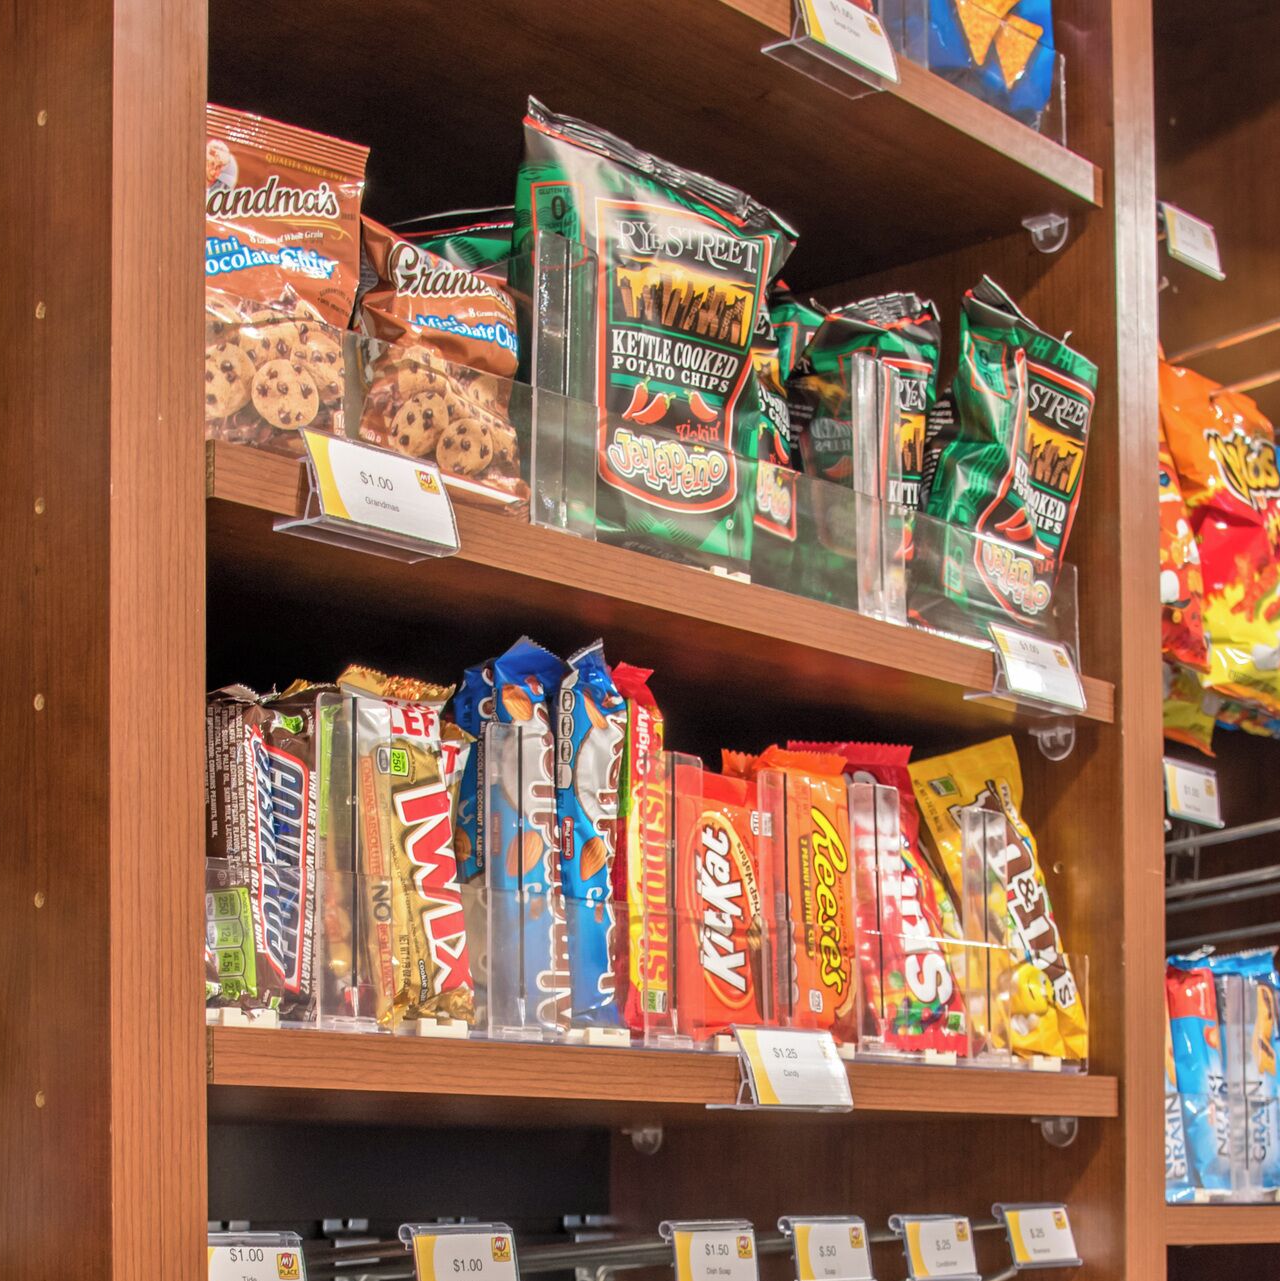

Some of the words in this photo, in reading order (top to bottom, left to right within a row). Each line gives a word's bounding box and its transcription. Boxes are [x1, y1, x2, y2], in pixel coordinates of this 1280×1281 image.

[207, 176, 339, 220] andma's
[612, 329, 671, 364] KETTLE
[673, 342, 738, 379] COOKED
[612, 355, 675, 381] POTATO
[681, 369, 730, 393] CHIPS
[360, 471, 394, 492] $1.00
[365, 497, 400, 513] Grandmas
[392, 752, 402, 772] 250
[308, 771, 317, 806] WHO
[307, 808, 316, 826] ARE
[306, 828, 315, 853] YOU
[394, 783, 475, 993] TWIX
[218, 895, 229, 916] 250
[811, 806, 848, 994] Reese's
[303, 891, 314, 938] YOU'RE
[300, 938, 313, 995] HUNGRY?
[647, 992, 657, 1011] 240
[773, 1046, 798, 1060] $1.25
[783, 1069, 800, 1079] Candy
[230, 1247, 264, 1263] $1.00
[705, 1242, 729, 1257] $1.50
[453, 1258, 483, 1274] $1.00
